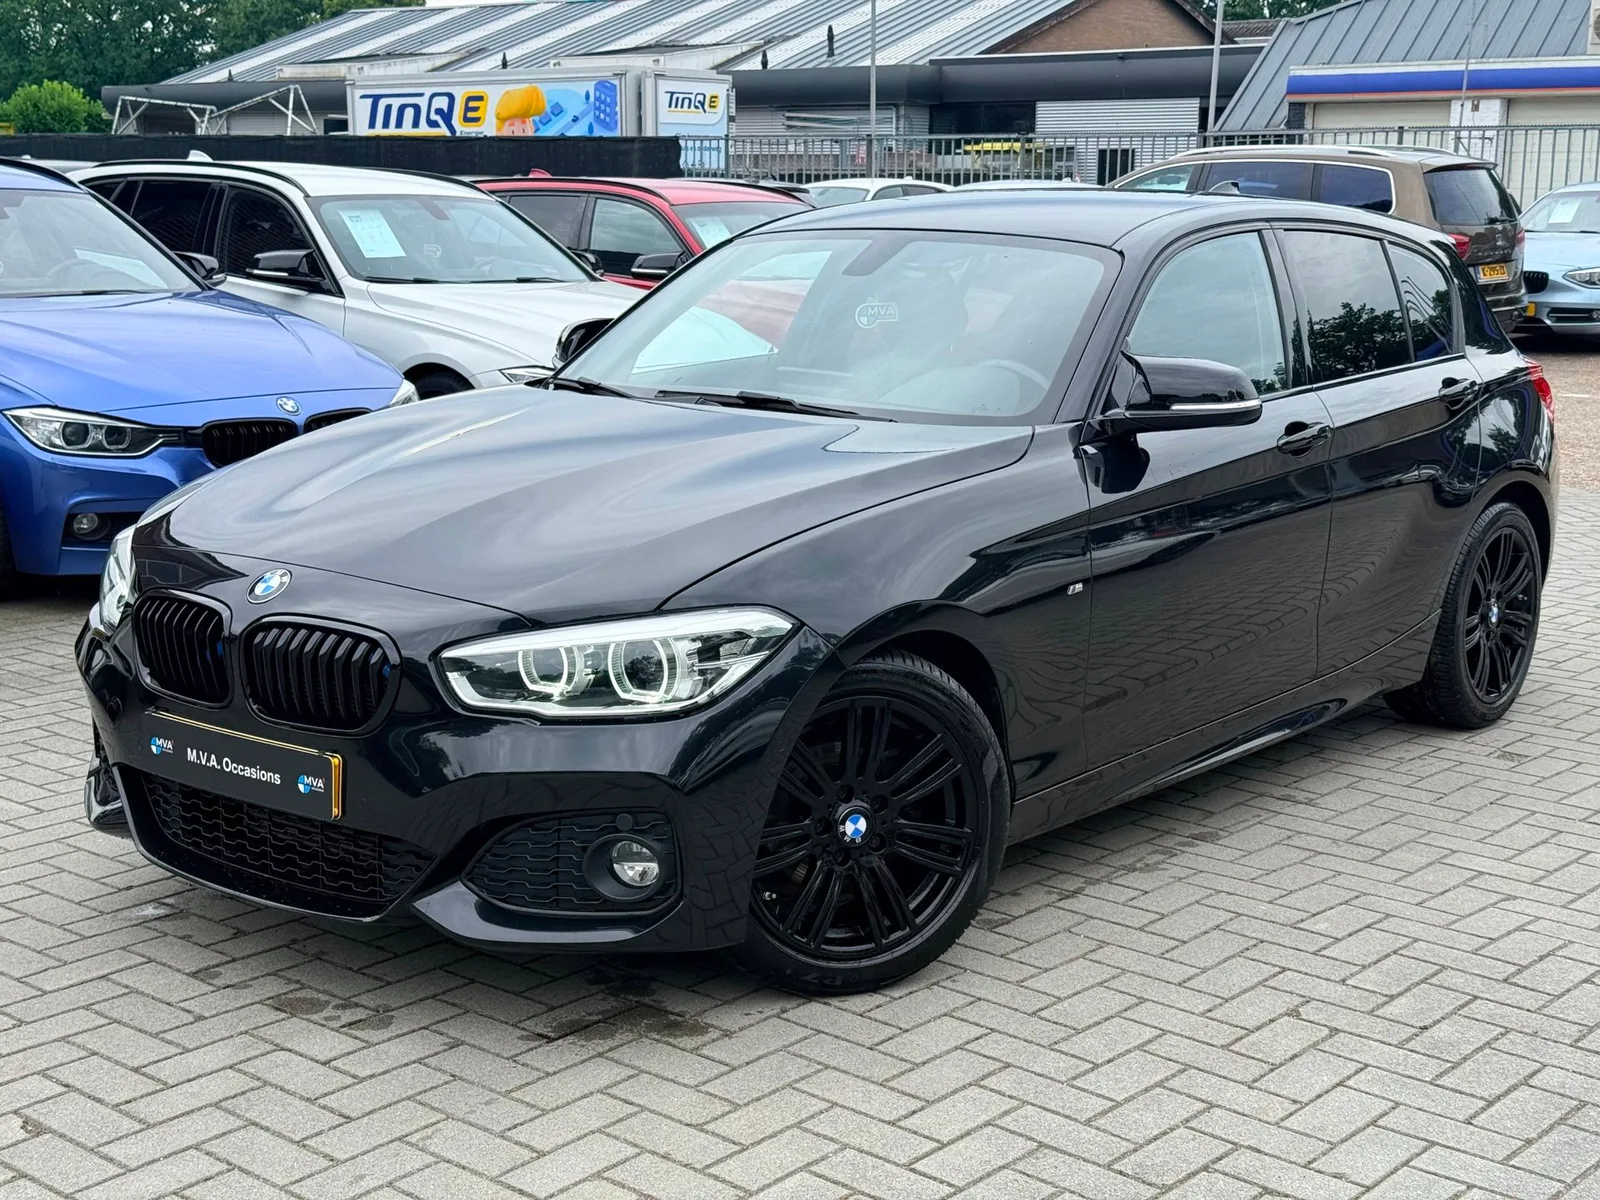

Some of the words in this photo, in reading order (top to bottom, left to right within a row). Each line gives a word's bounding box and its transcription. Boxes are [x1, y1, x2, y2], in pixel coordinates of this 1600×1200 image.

[868, 306, 895, 316] MVA
[155, 737, 174, 750] MVA
[187, 747, 221, 769] M.V.A.
[222, 757, 281, 785] Occasions
[304, 774, 325, 789] MVA
